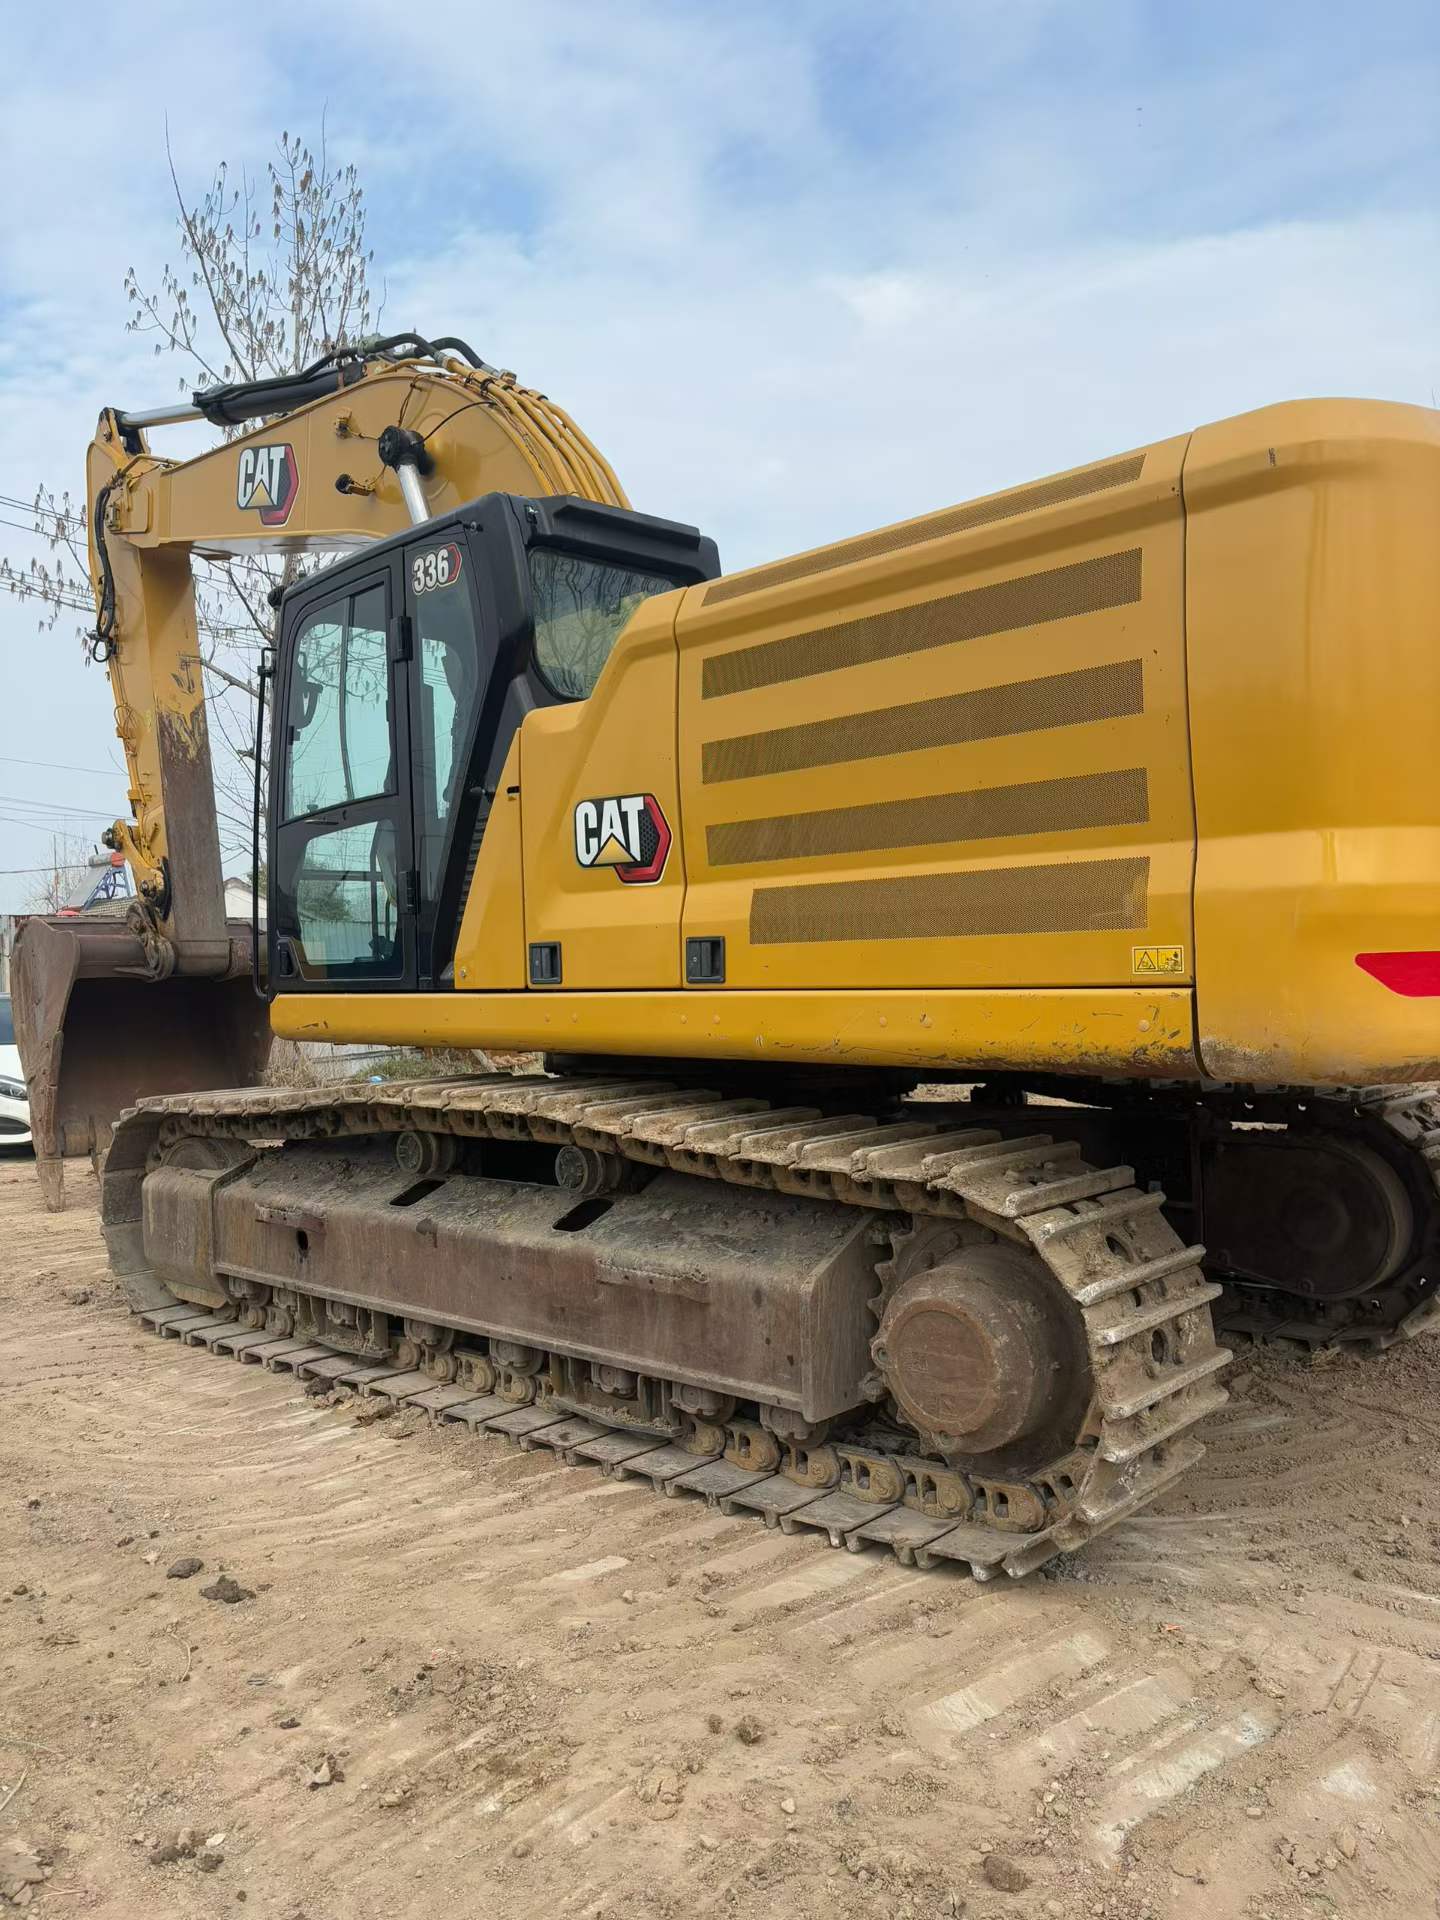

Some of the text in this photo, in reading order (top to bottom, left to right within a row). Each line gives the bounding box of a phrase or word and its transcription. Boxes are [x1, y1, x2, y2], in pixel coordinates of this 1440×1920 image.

[238, 445, 286, 508] CAT
[413, 548, 450, 592] 336
[575, 796, 645, 866] CAT
